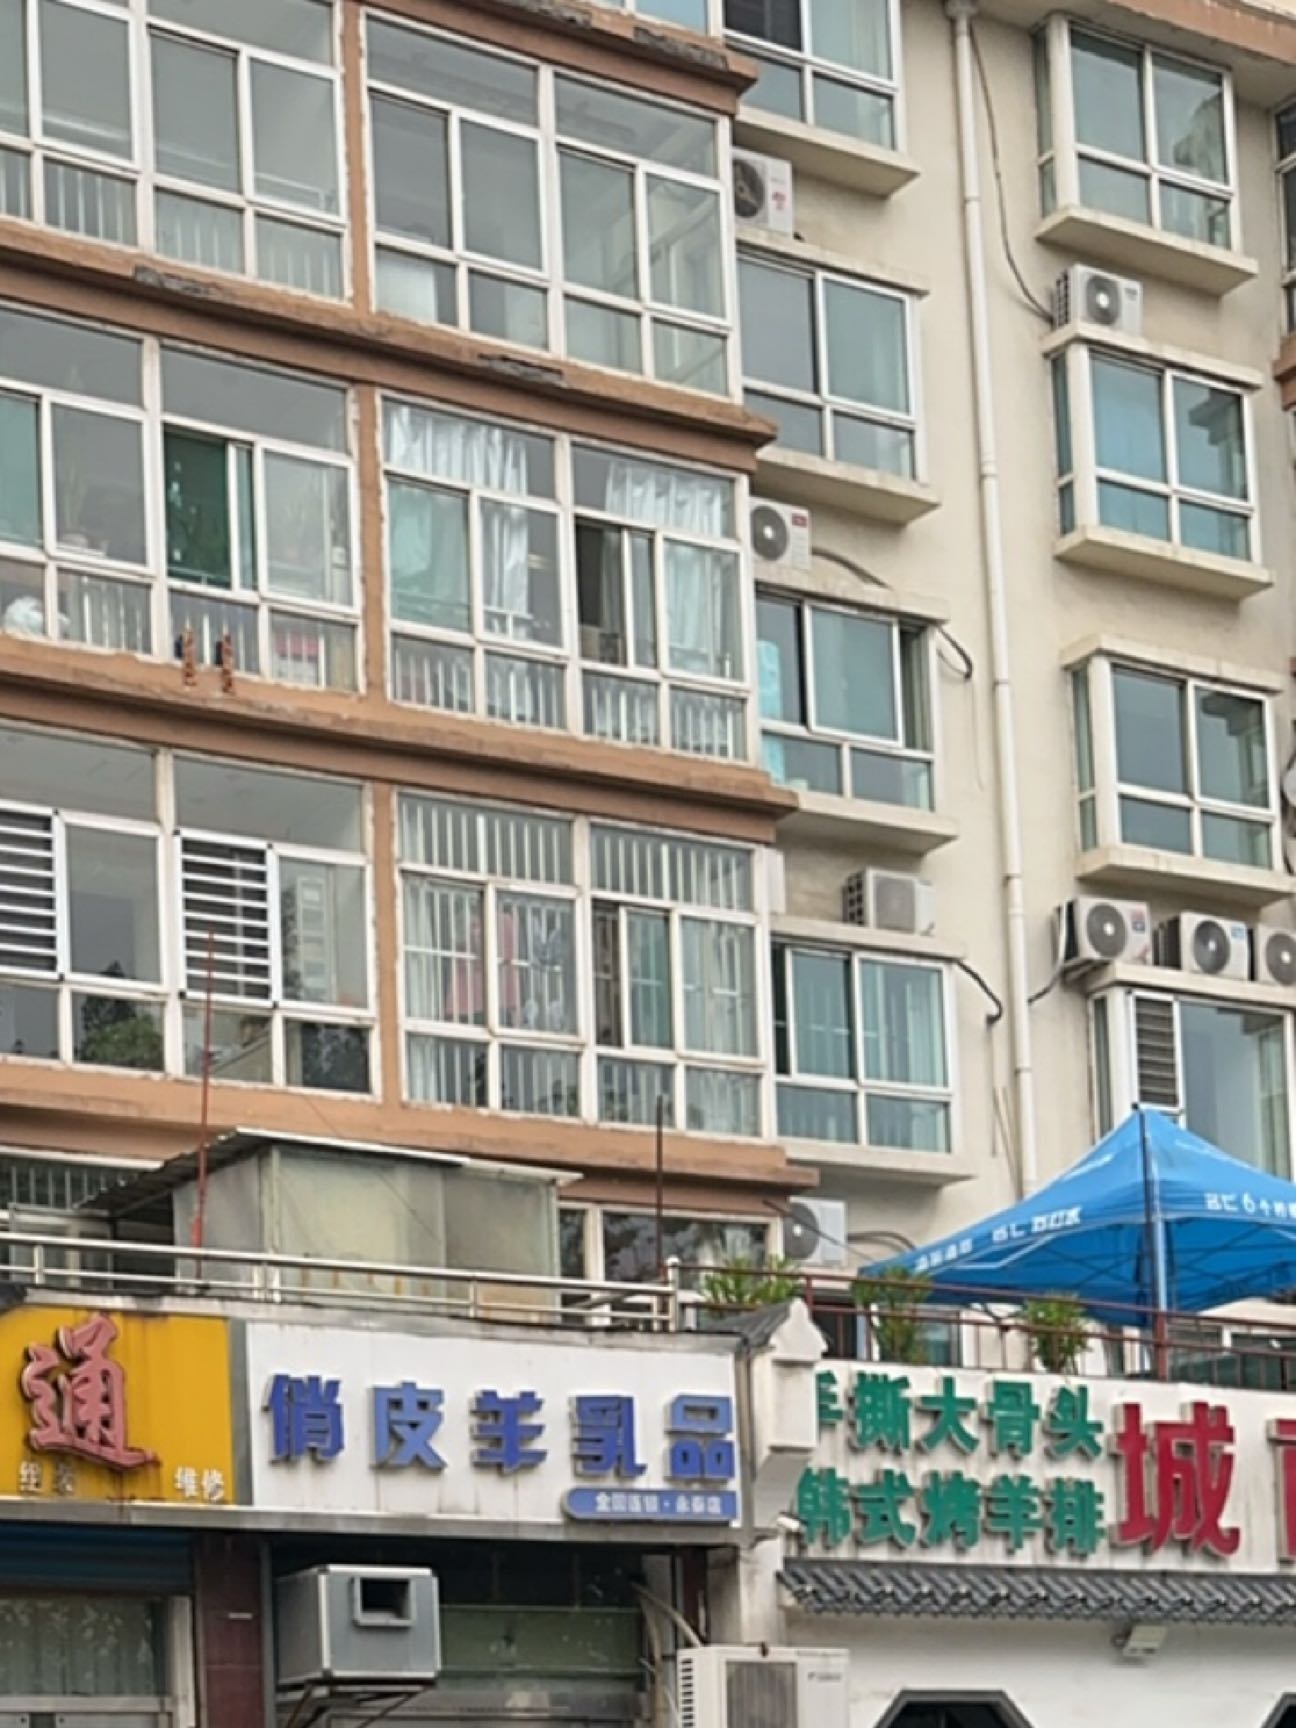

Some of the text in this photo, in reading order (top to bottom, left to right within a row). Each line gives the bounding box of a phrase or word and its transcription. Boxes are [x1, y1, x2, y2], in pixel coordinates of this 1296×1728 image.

[264, 1373, 737, 1480] 俏皮羊乳品
[174, 1466, 225, 1502] 维修
[797, 1467, 1107, 1554] 韩式烤羊排
[1110, 1402, 1296, 1560] 城
